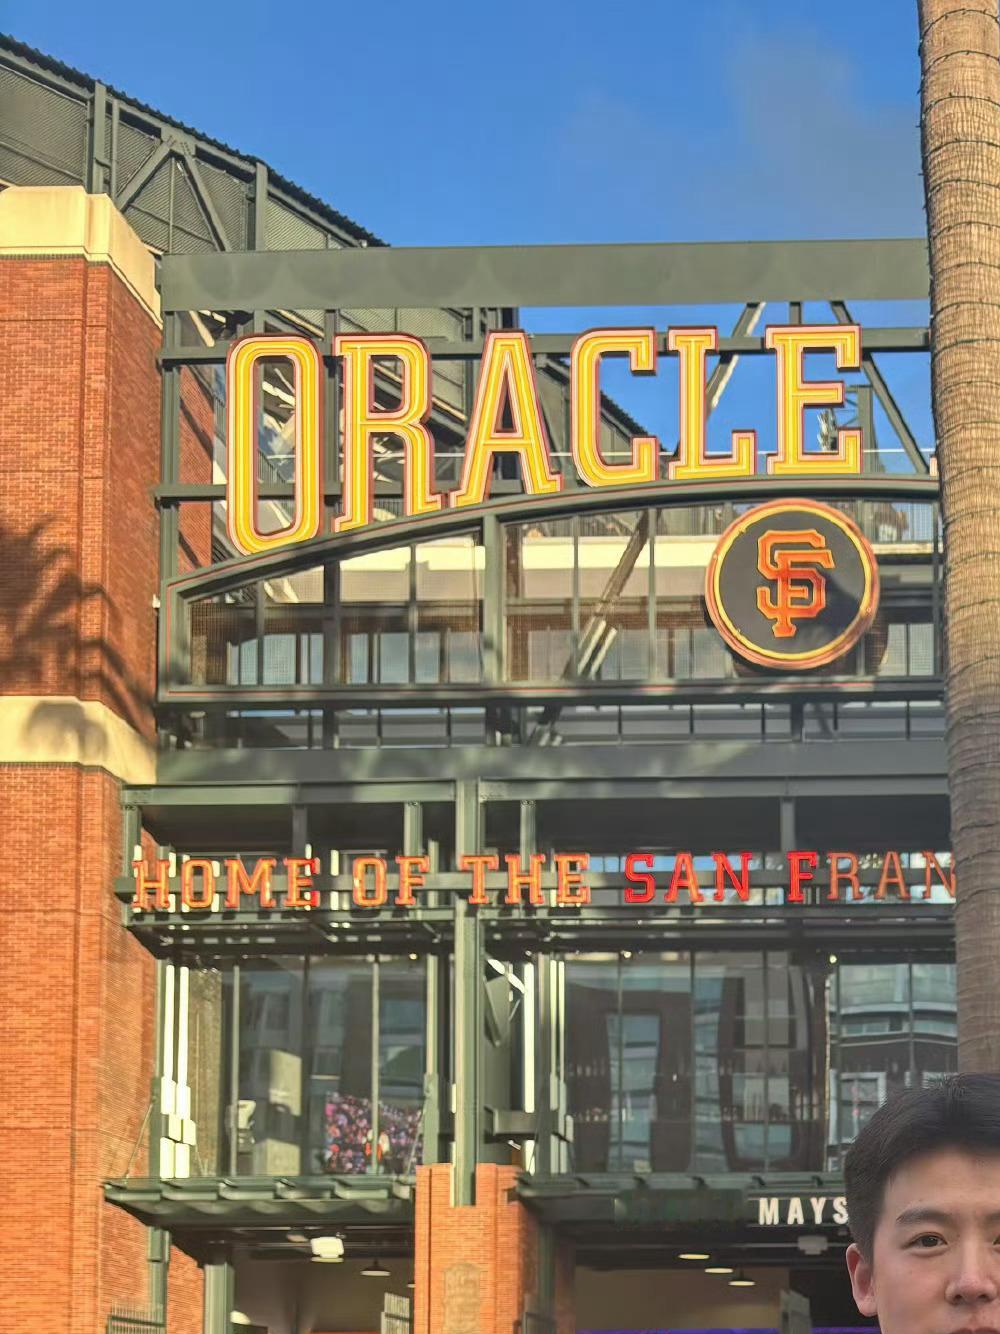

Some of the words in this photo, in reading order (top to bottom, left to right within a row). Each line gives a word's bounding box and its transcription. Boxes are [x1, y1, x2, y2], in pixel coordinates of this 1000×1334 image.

[226, 322, 863, 557] ORACLE
[756, 528, 834, 639] SF
[132, 855, 321, 912] HOME
[352, 854, 430, 908] OF
[458, 853, 590, 904] THE
[623, 850, 752, 903] SAN
[759, 1196, 849, 1226] MAYS
